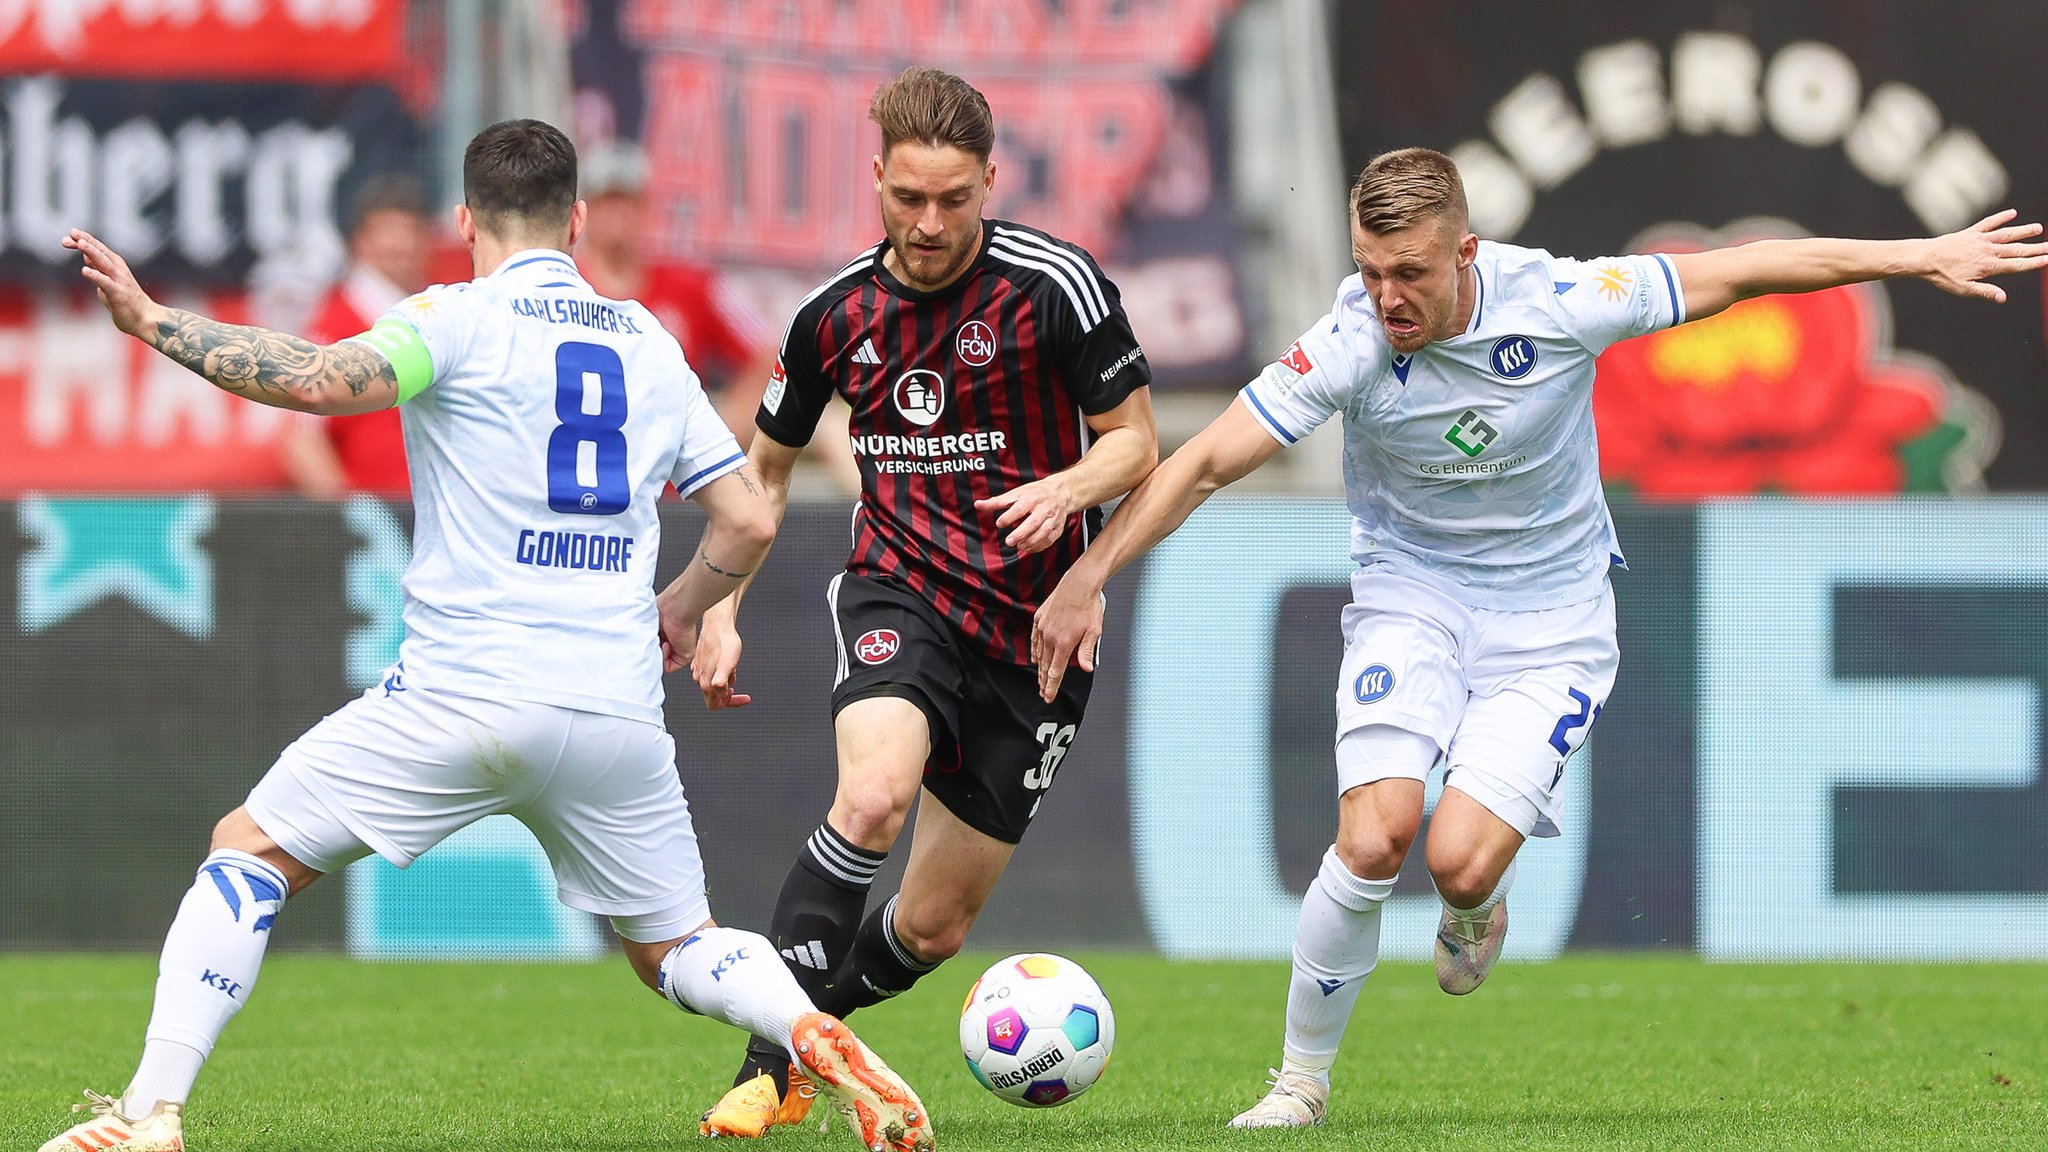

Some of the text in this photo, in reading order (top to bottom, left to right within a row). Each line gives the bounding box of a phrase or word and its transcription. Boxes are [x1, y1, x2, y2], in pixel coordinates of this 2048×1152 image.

[0, 73, 355, 294] berg
[509, 298, 643, 334] KARLSRUHER SC
[960, 339, 992, 357] FCN
[1100, 346, 1143, 383] HEIMSAUE
[1498, 340, 1529, 373] KSC
[547, 341, 630, 515] 8
[850, 430, 1006, 457] NÜRNBERGER
[875, 457, 985, 475] VERSICHERUNG
[1419, 455, 1526, 475] CG Elementum
[516, 529, 634, 573] GONDORF
[861, 639, 896, 658] FCN
[1360, 669, 1388, 698] KSC
[1023, 722, 1076, 790] 36
[711, 946, 750, 983] KSC
[200, 968, 242, 999] KSC
[989, 1047, 1065, 1088] DERBYSTAR
